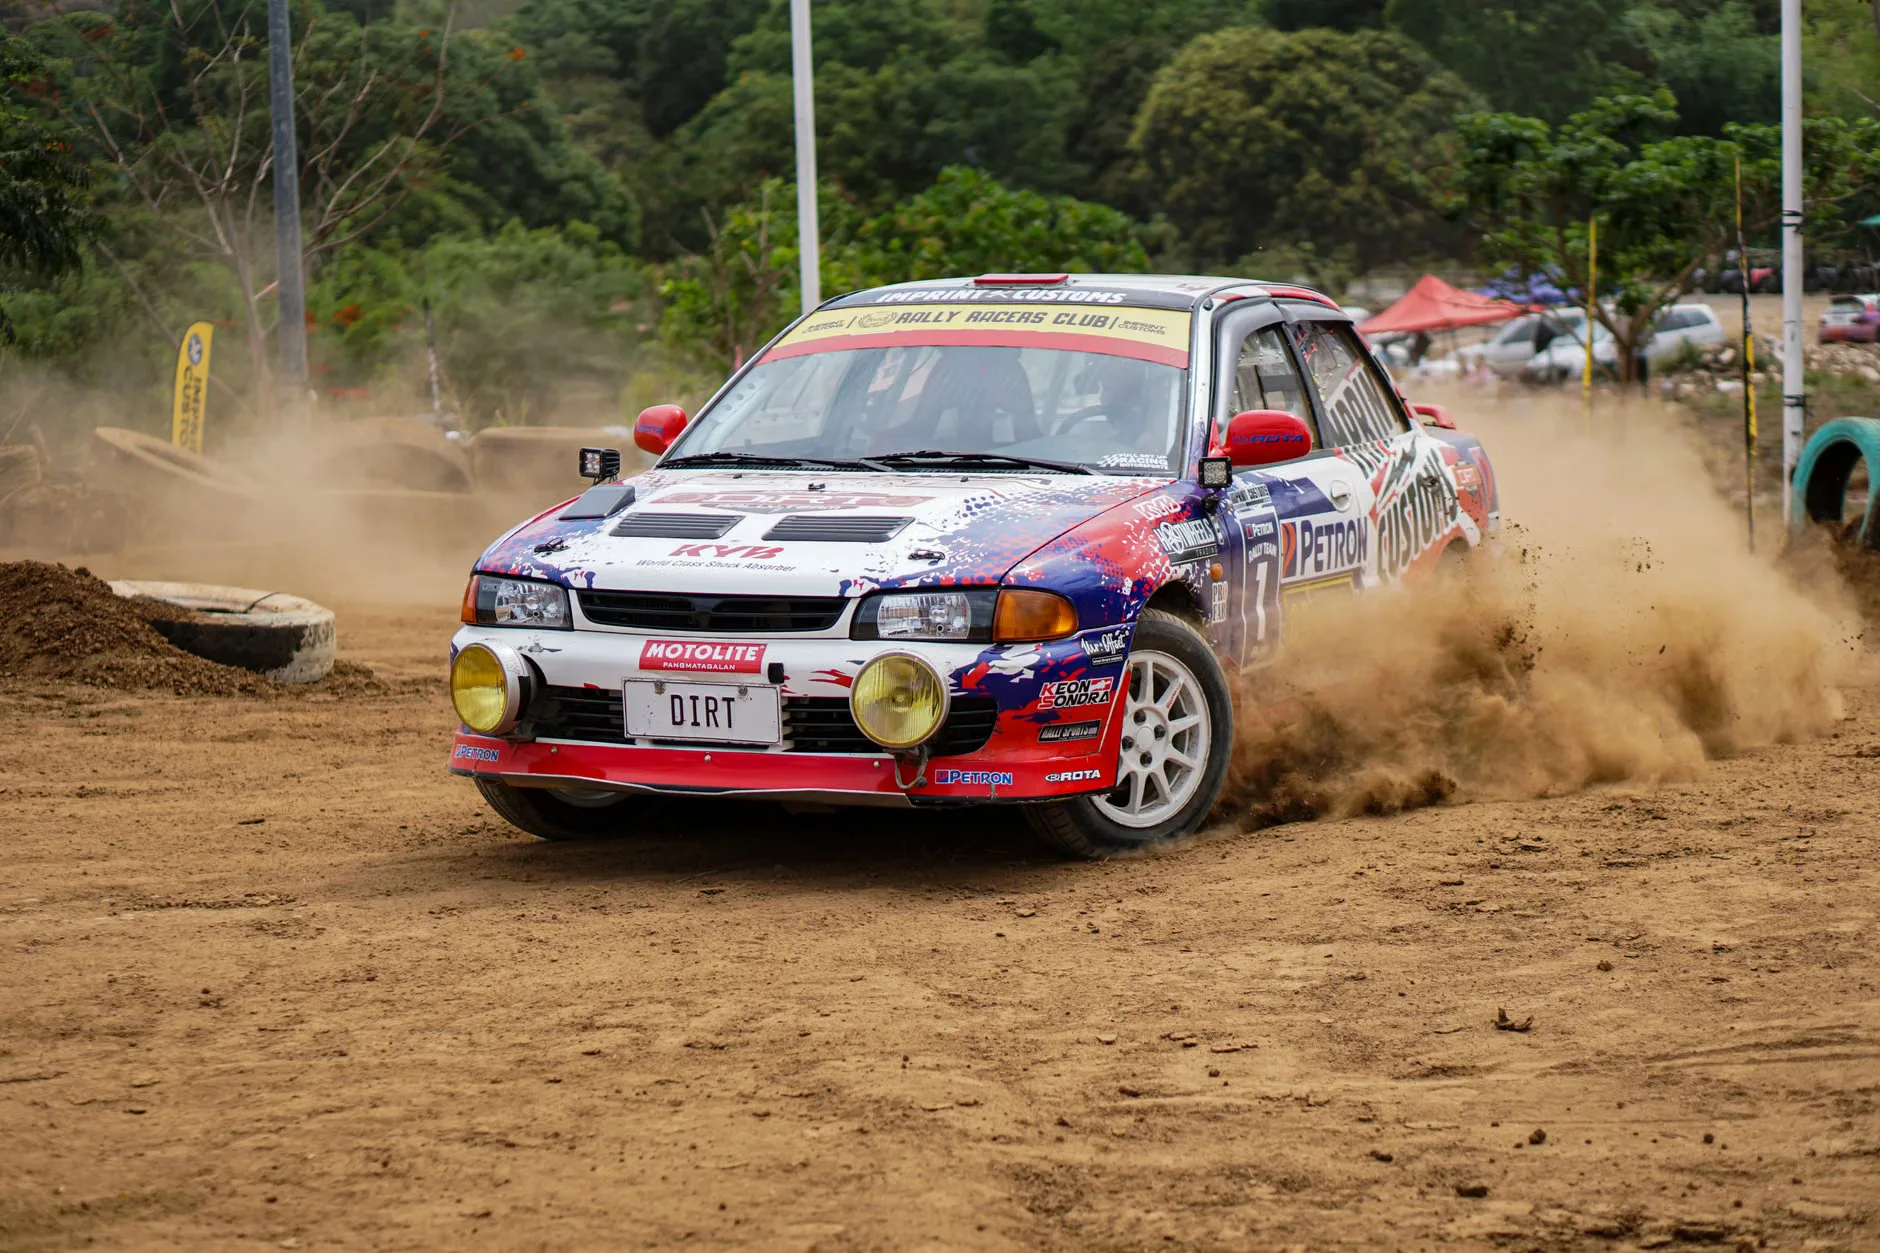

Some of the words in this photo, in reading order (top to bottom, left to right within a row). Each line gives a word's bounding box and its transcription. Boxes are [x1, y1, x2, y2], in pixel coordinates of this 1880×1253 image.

[876, 289, 989, 303] IMPRINT
[1013, 289, 1127, 304] CUSTOMS
[895, 310, 964, 324] RALLY
[965, 311, 1048, 325] RACERS
[1052, 312, 1110, 328] CLUB
[1123, 320, 1167, 330] IMPRINT
[1118, 323, 1166, 335] CUSTOMS
[1250, 433, 1304, 443] ROTA
[1119, 457, 1168, 465] RACING
[1251, 521, 1274, 537] PETRON
[668, 543, 785, 560] KYB
[1301, 516, 1368, 576] PETRON
[636, 559, 670, 567] World
[671, 559, 703, 567] Class
[705, 560, 742, 568] Shock
[742, 562, 797, 572] Absorber
[1255, 560, 1268, 641] 1
[645, 643, 759, 661] MOTOLITE
[663, 661, 736, 670] PANGMATAGALAN
[1040, 679, 1091, 695] KEON
[1037, 691, 1110, 710] SONDRA
[670, 694, 736, 729] DIRT
[460, 745, 500, 762] PETRON
[950, 769, 1013, 785] PETRON
[1060, 769, 1101, 782] ROTA
